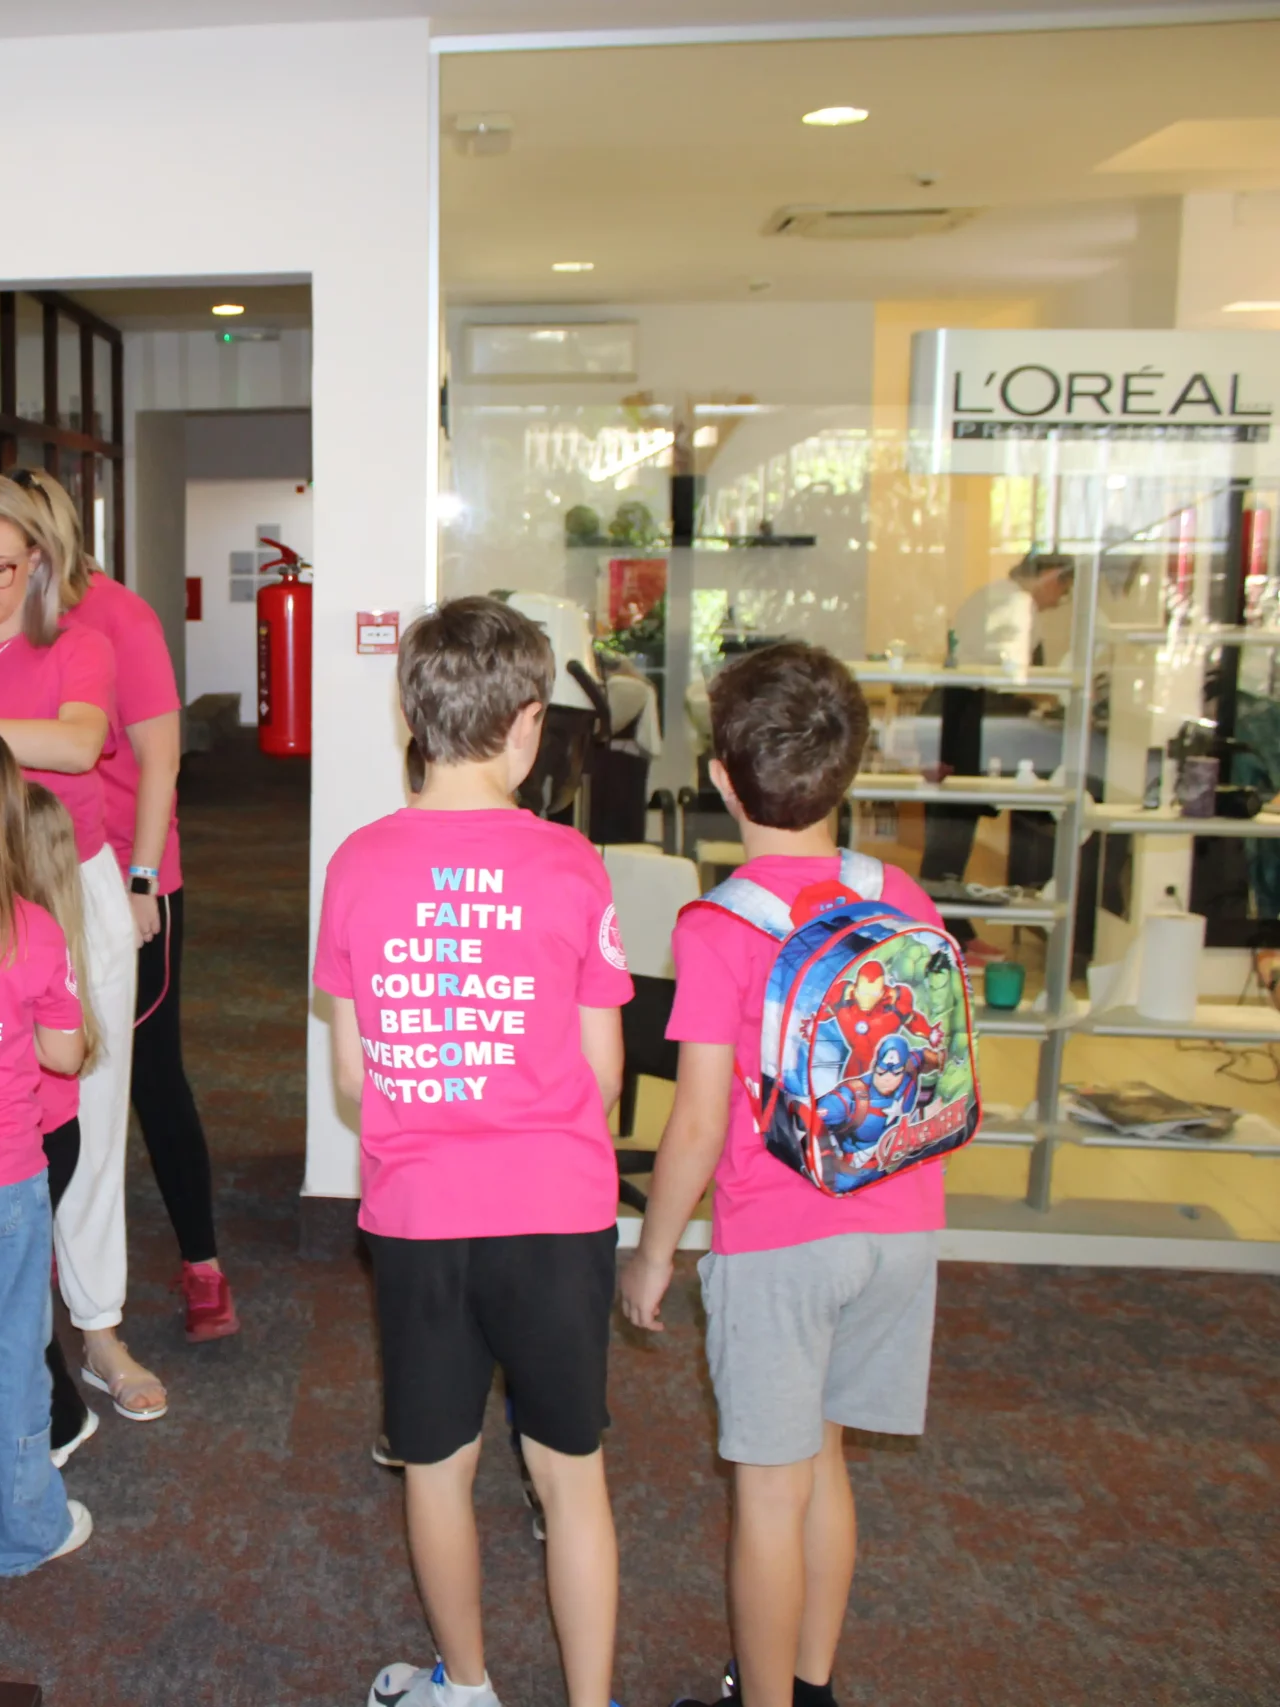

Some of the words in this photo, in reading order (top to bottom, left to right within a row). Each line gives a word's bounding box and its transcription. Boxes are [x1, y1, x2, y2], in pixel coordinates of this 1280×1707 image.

[953, 364, 1273, 416] L'ORÉAL
[431, 867, 503, 893] WIN
[416, 902, 522, 931] FAITH
[383, 938, 482, 964] CURE
[371, 973, 535, 1000] COURAGE
[380, 1007, 525, 1034] BELIEVE
